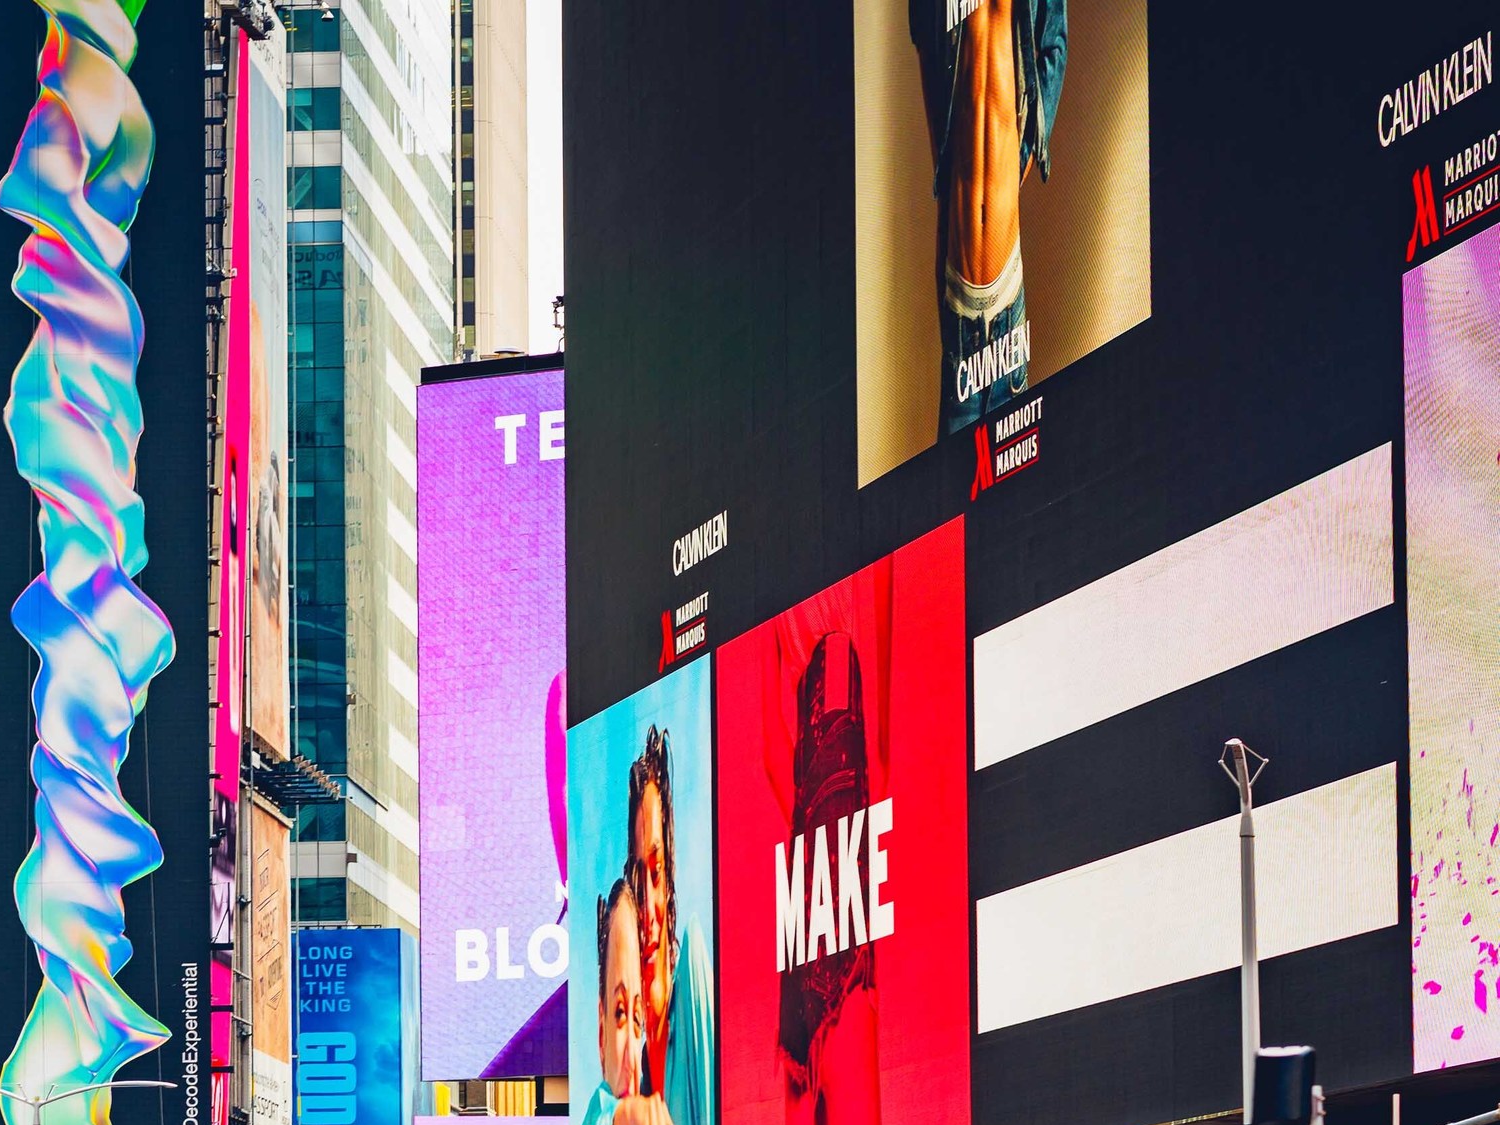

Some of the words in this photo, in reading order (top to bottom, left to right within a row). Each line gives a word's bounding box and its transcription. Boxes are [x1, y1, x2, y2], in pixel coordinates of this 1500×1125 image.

[1378, 63, 1440, 148] CALVIN
[1443, 30, 1493, 111] KLEIN
[1444, 174, 1500, 228] MARQUI
[956, 347, 998, 404] CALVIN
[997, 320, 1032, 381] KLEIN
[995, 396, 1044, 442] MARRIOTT
[995, 433, 1039, 477] MARQUIS
[672, 526, 702, 577] CALVIN
[702, 509, 729, 563] KLEIN
[675, 591, 710, 628] MARRIOTT
[675, 620, 706, 655] MARQUIS
[774, 797, 895, 974] MAKE
[298, 945, 353, 961] LONG
[302, 963, 348, 978] LIVE
[454, 922, 569, 984] BLO
[300, 998, 352, 1013] KING
[305, 981, 346, 995] THE
